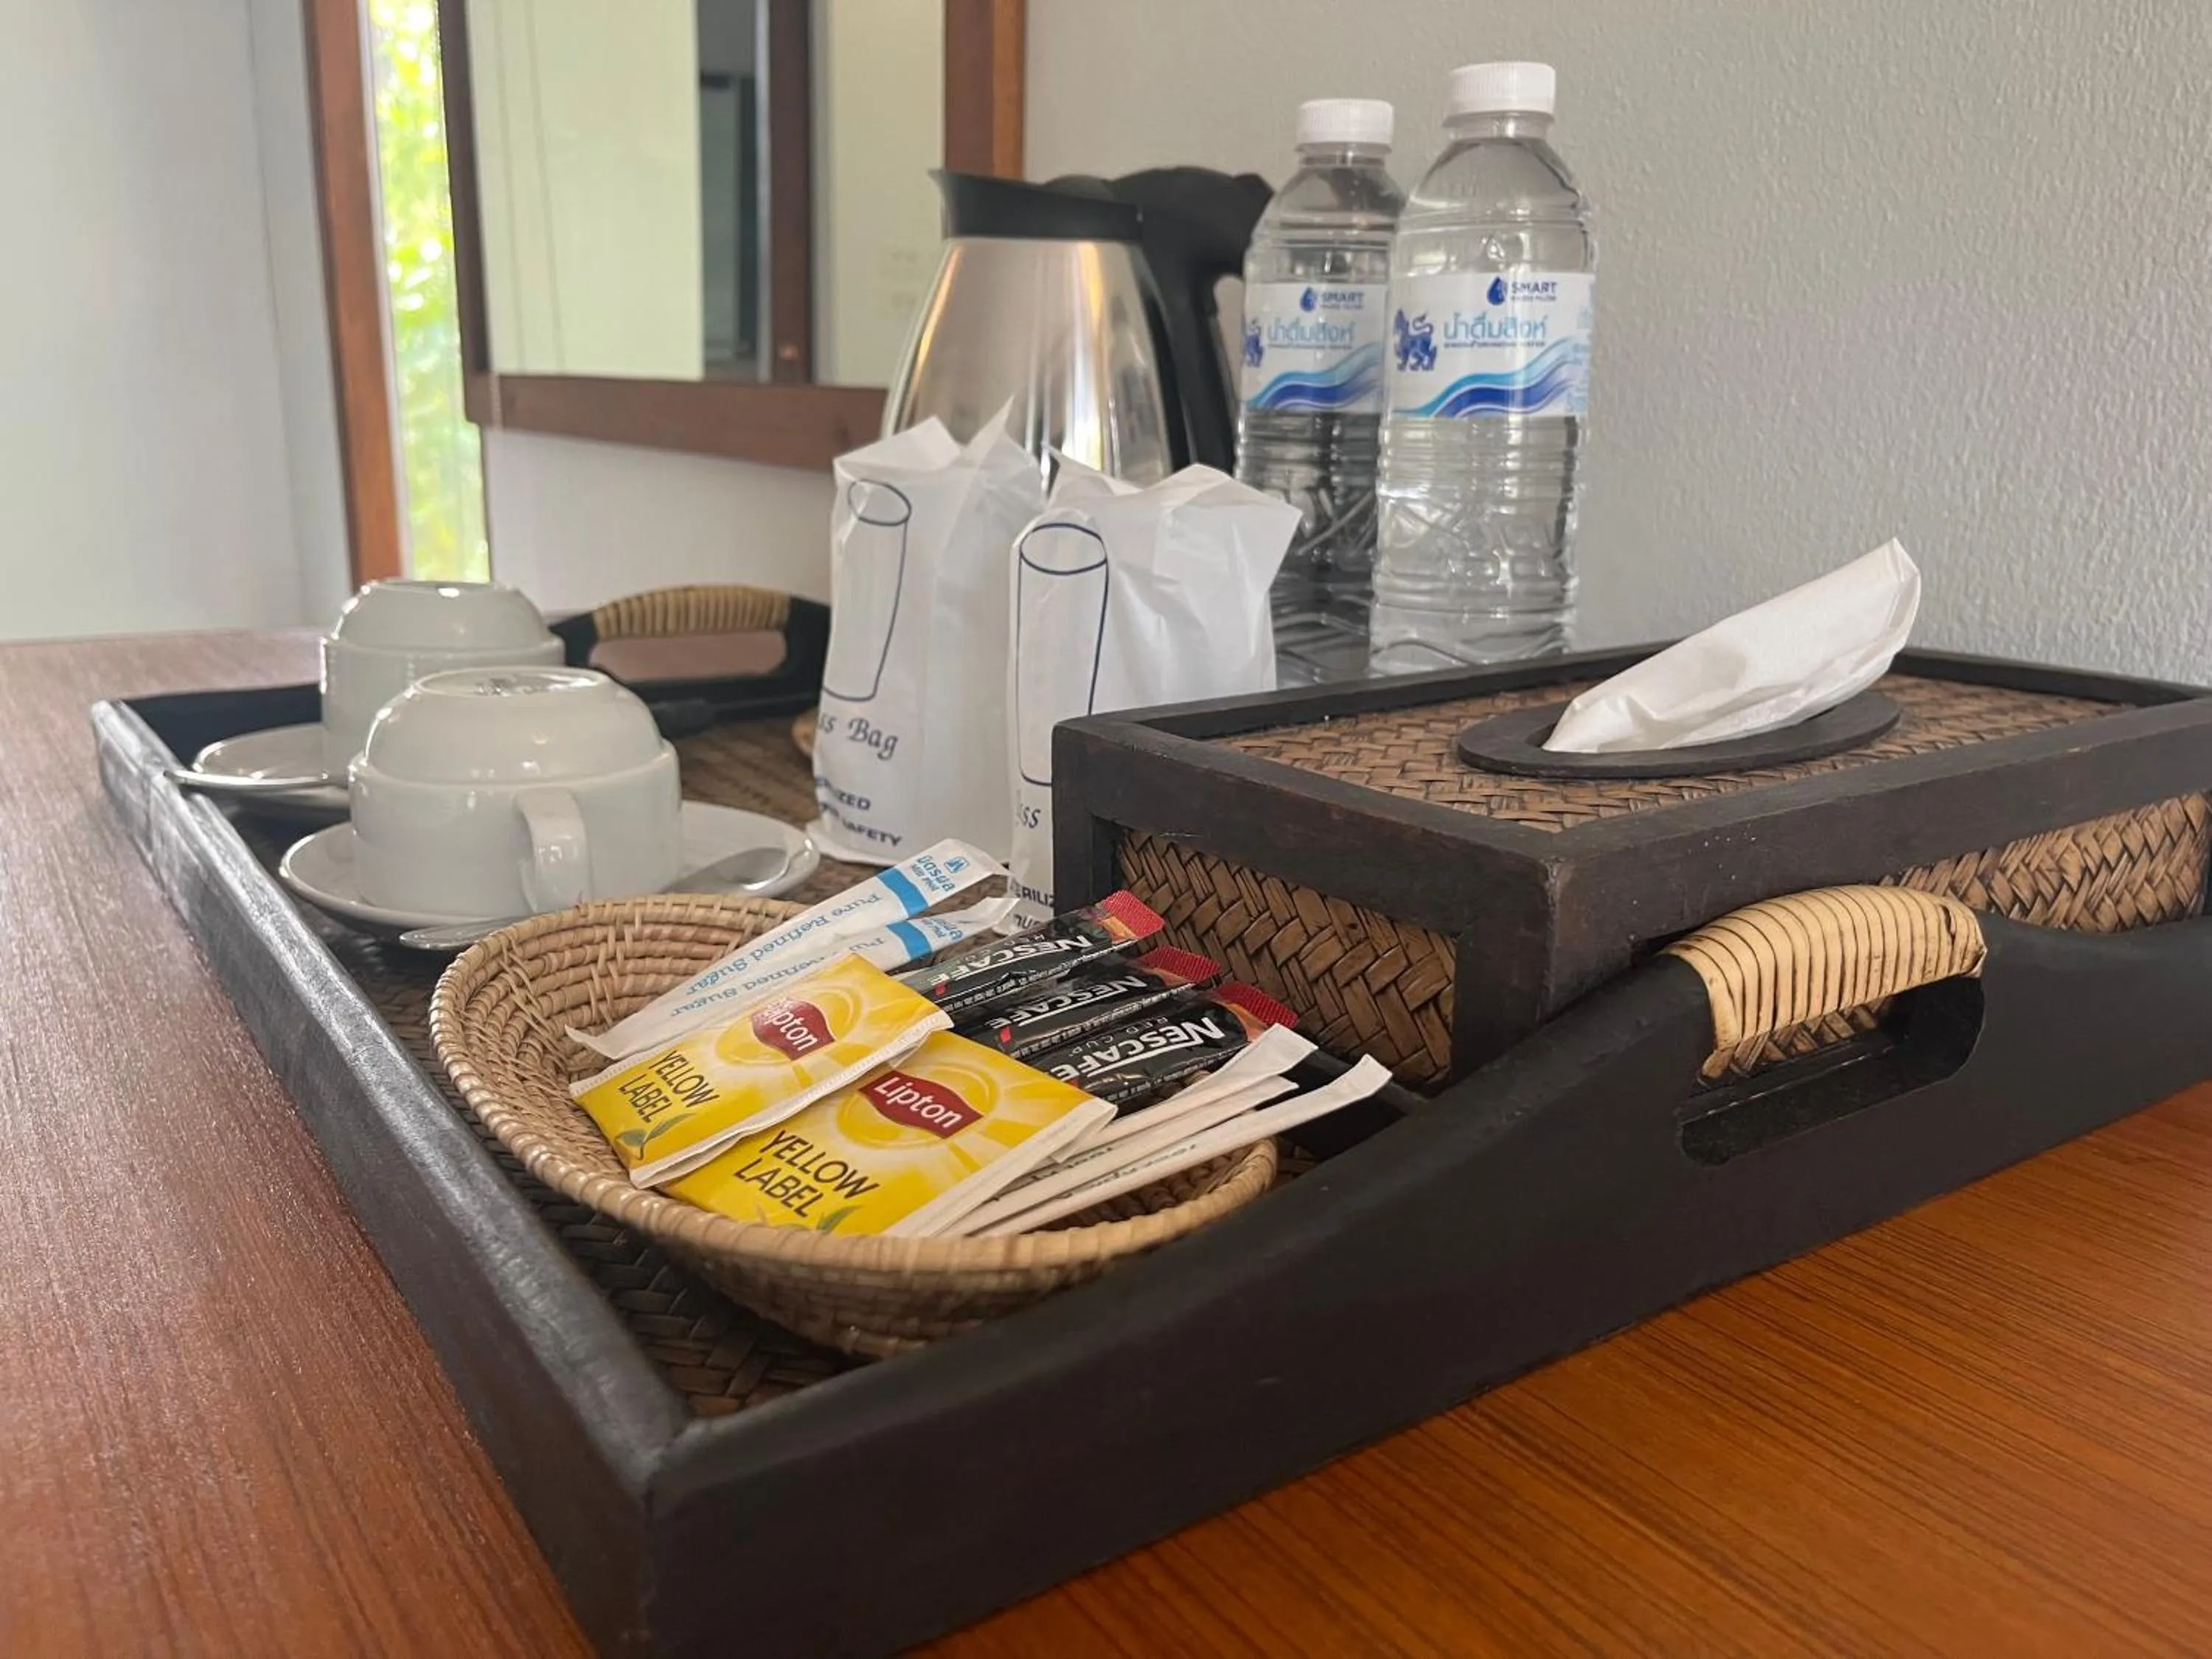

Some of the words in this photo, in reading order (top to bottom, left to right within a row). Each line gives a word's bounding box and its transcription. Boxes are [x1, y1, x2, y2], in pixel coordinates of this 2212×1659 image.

[1321, 291, 1365, 303] SMART
[1510, 281, 1557, 295] SMART
[848, 717, 899, 761] Bag
[832, 893, 883, 917] Pure
[751, 915, 830, 961] Refined
[686, 959, 749, 995] Sugar
[669, 987, 738, 1017] Sugar
[763, 997, 818, 1051] Lipton
[1072, 1033, 1114, 1053] CUP
[618, 1073, 672, 1123] LABEL
[648, 1049, 720, 1107] YELLOW
[873, 1077, 963, 1128] Lipton
[734, 1158, 824, 1217] LABEL
[758, 1130, 880, 1200] YELLOW
